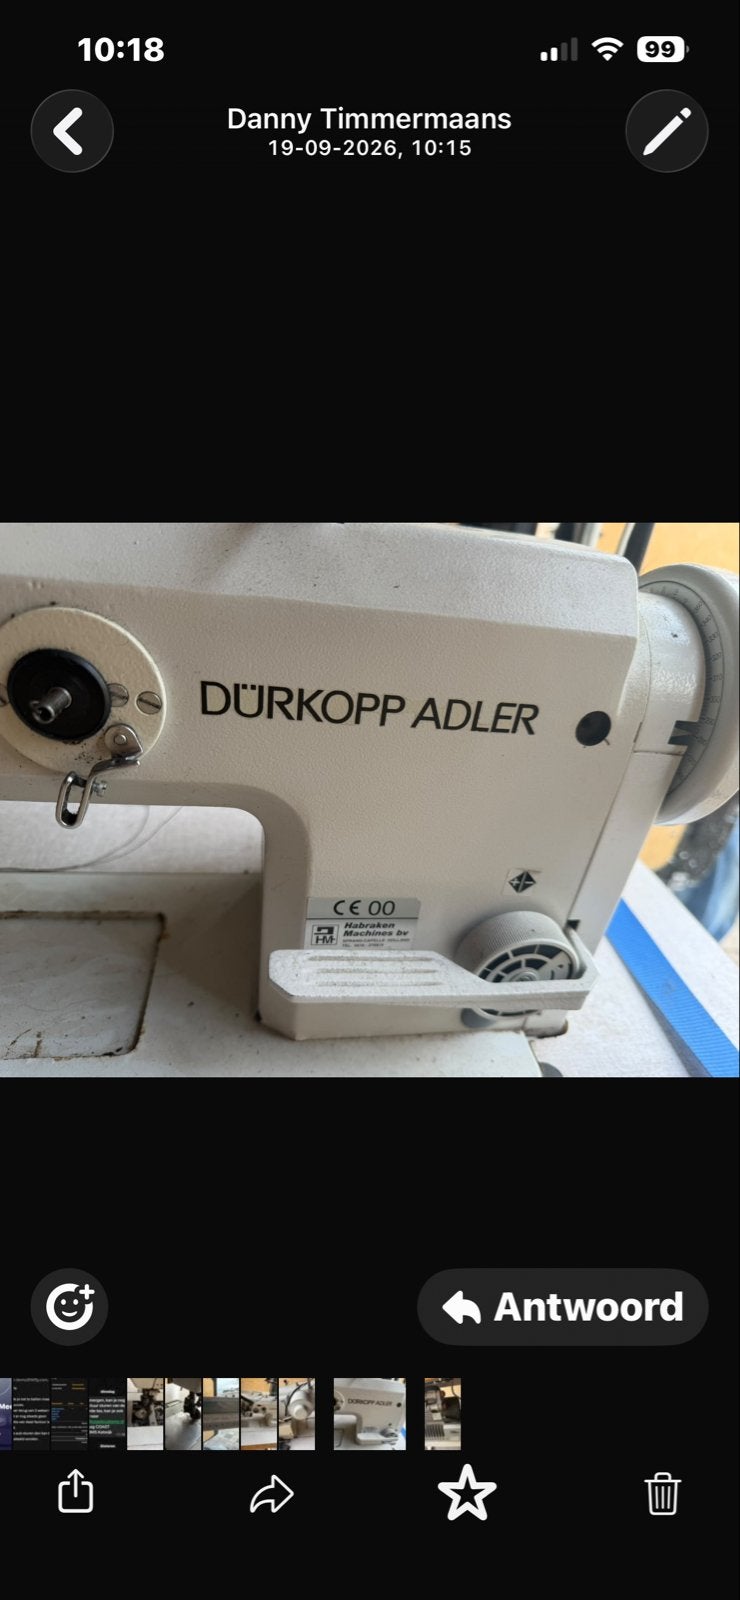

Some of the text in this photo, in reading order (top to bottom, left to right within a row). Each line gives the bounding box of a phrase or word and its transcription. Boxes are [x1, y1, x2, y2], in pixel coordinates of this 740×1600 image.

[78, 37, 164, 62] 10:18
[645, 40, 676, 58] 99
[228, 107, 512, 134] Danny Timmermaans
[269, 140, 472, 159] 19-09-2026, 10:15
[200, 680, 540, 735] DÜRKOPP ADLER
[368, 900, 396, 916] 00
[344, 921, 396, 929] Habraken
[494, 1291, 683, 1322] Antwoord
